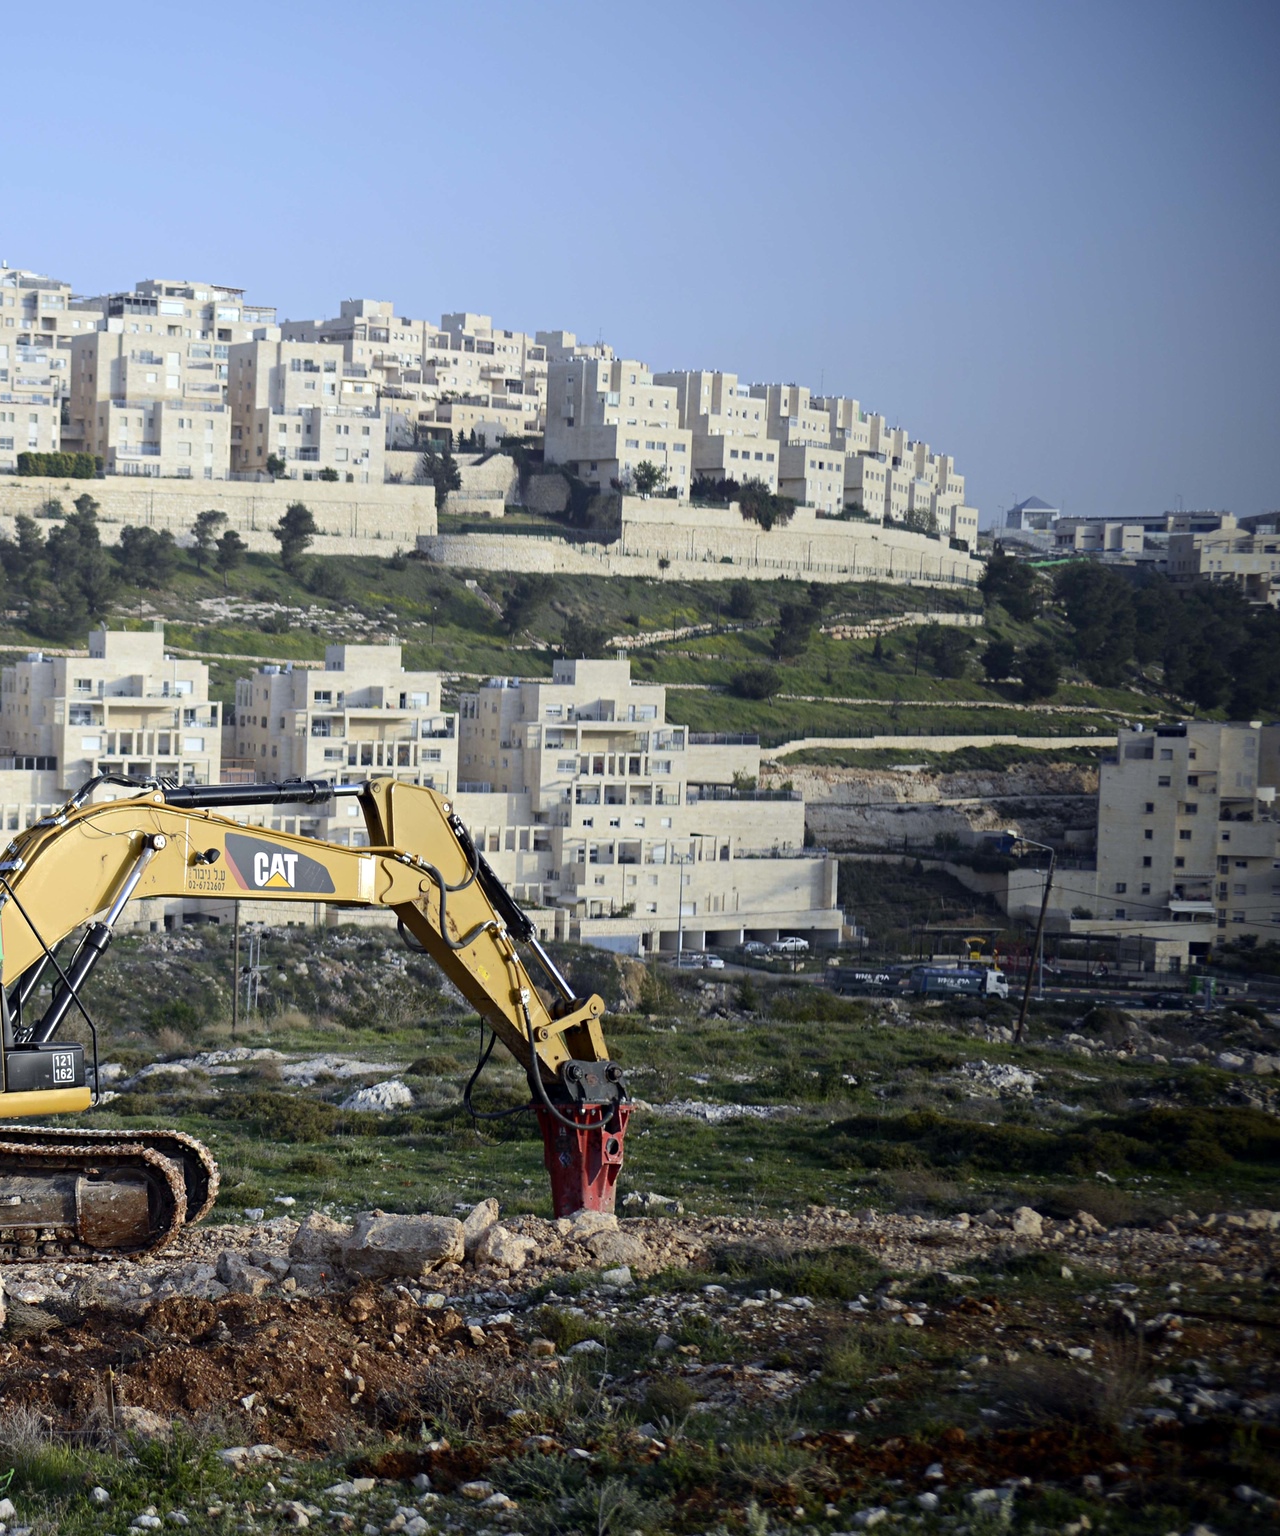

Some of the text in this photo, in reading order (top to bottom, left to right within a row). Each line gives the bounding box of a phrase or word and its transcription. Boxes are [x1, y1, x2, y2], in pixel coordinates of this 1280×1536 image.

[254, 852, 298, 888] CAT
[188, 880, 225, 891] 02-6722607
[54, 1054, 71, 1067] 121
[55, 1068, 72, 1080] 162
